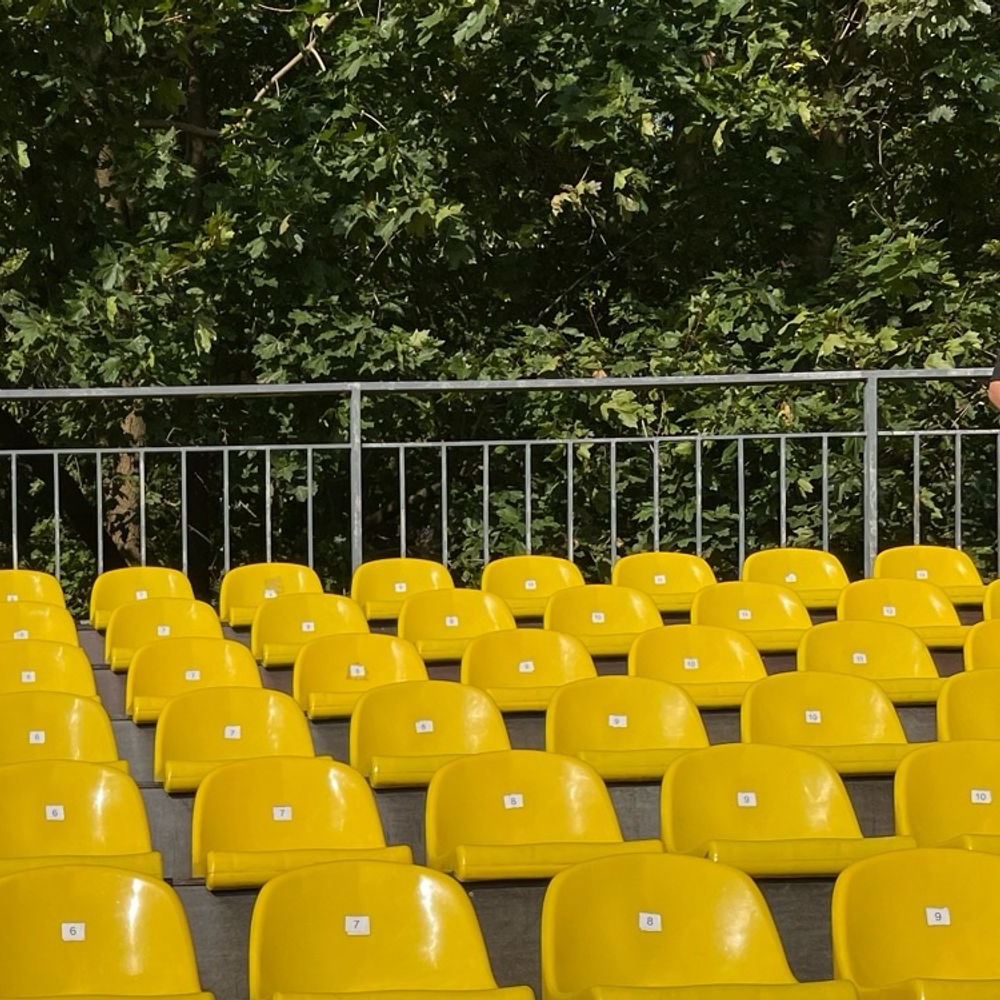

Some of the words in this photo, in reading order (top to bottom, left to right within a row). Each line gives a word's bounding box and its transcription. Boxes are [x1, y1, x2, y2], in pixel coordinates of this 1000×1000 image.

[808, 713, 818, 722] 10
[510, 796, 518, 805] 8
[743, 794, 750, 804] 9
[975, 792, 987, 802] 10
[51, 808, 58, 818] 6
[278, 809, 286, 817] 7
[646, 916, 654, 926] 8
[934, 911, 942, 922] 9
[353, 919, 361, 929] 7
[69, 926, 77, 936] 6
